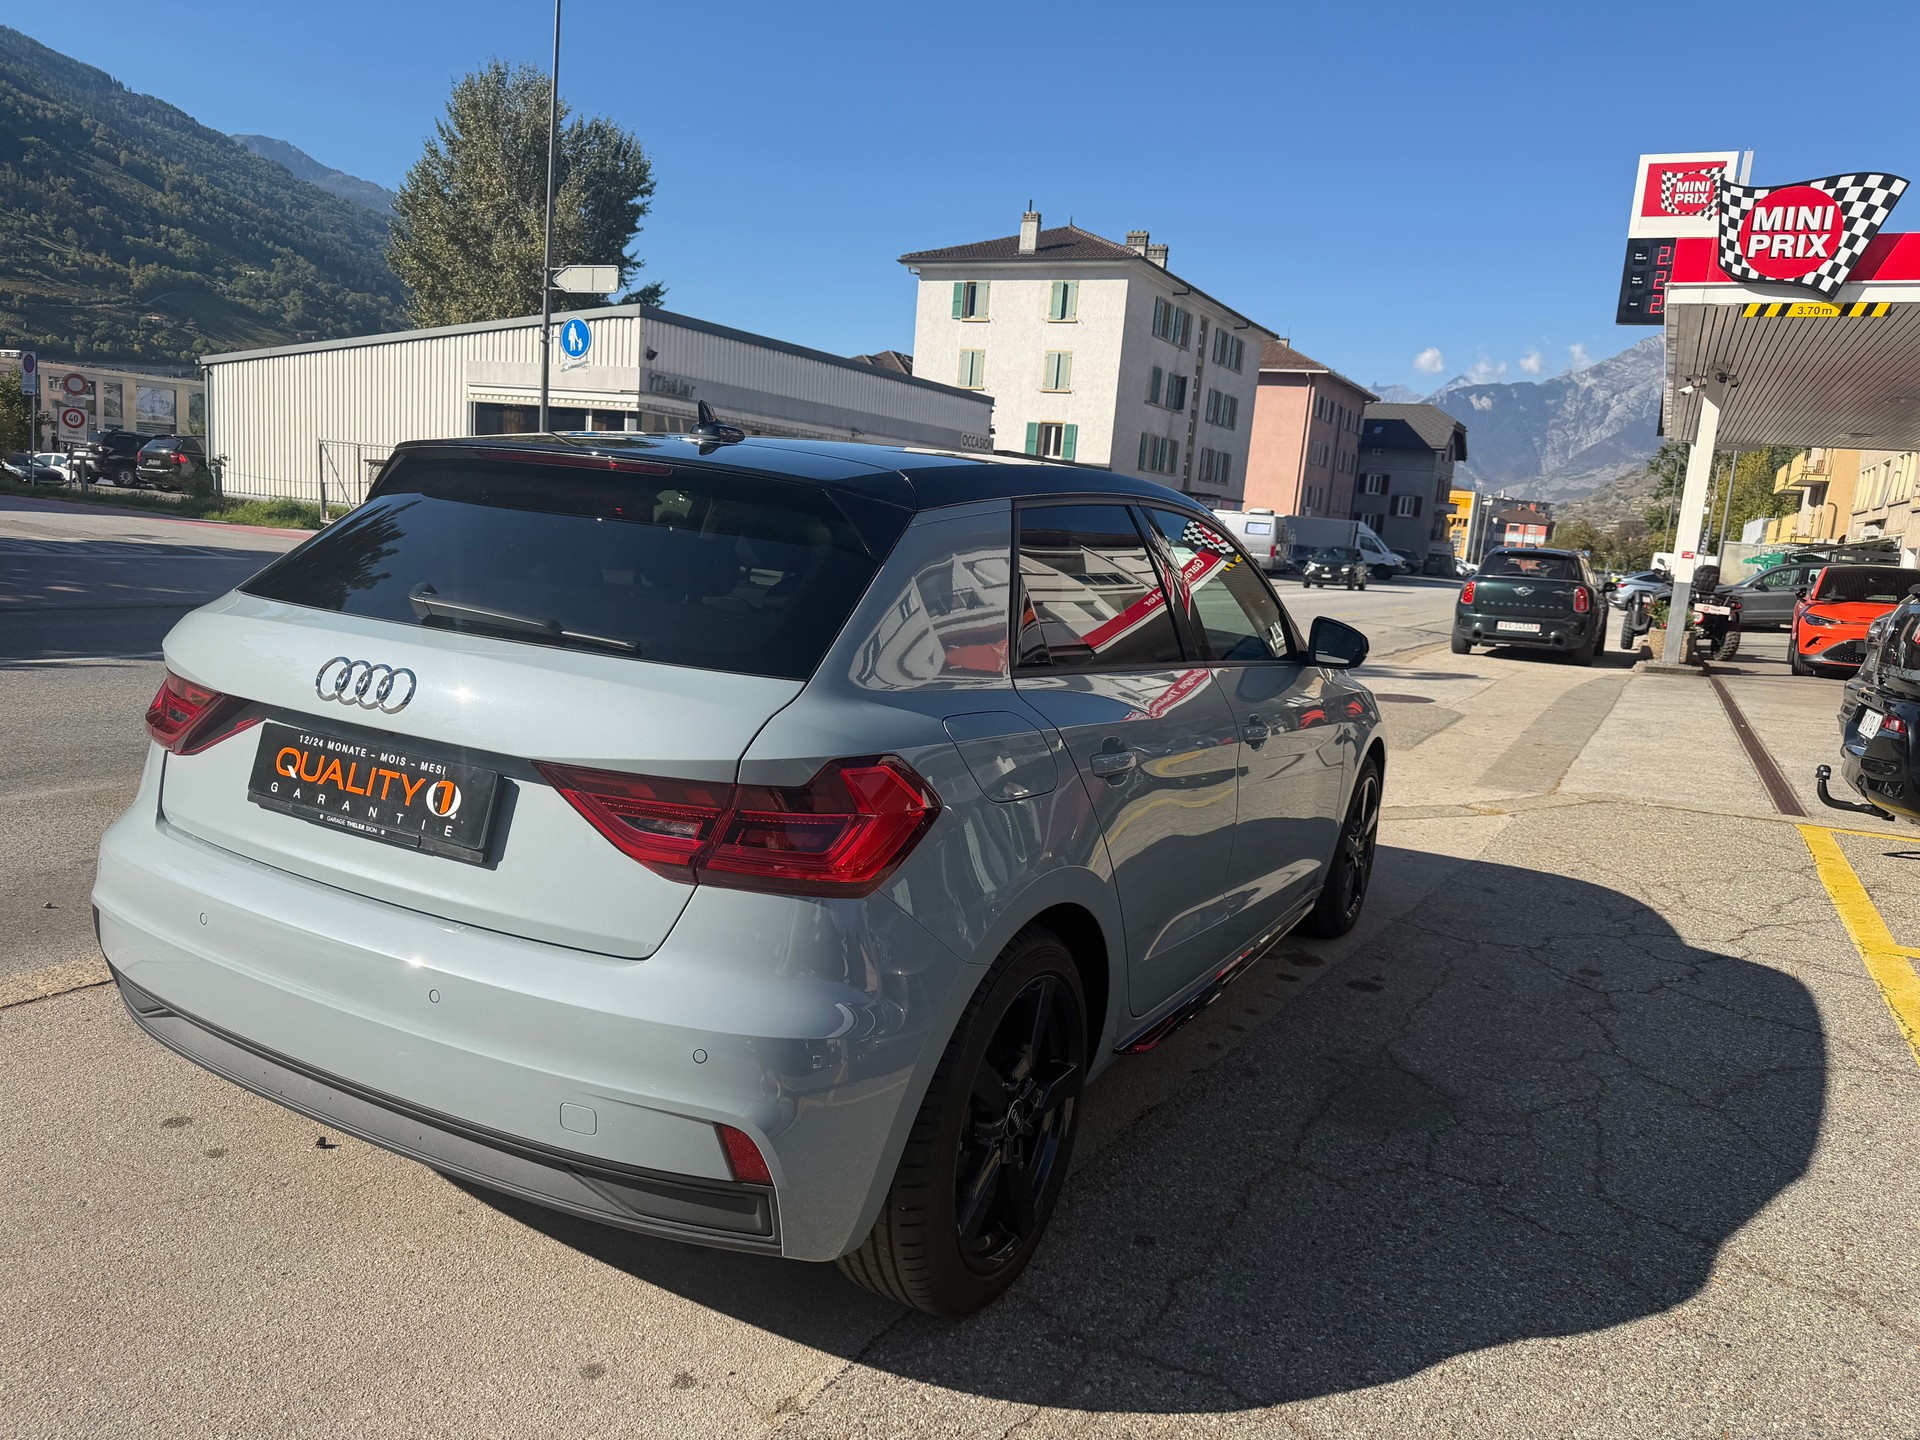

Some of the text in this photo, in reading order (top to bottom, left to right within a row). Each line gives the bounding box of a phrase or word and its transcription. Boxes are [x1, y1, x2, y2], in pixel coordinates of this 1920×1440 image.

[1675, 180, 1710, 193] MINI
[1674, 192, 1710, 205] PRIX
[1750, 205, 1836, 232] MINI
[1747, 232, 1831, 260] PRIX
[1797, 306, 1820, 315] 3.70
[68, 414, 79, 423] 40
[298, 734, 324, 747] 12/24
[327, 740, 367, 758] MONATE
[379, 752, 406, 766] MOIS
[420, 761, 447, 775] MESI
[275, 746, 426, 807] QUALITY
[270, 781, 453, 837] GARANTIE
[326, 815, 346, 826] GARAGE
[346, 820, 365, 831] THELER
